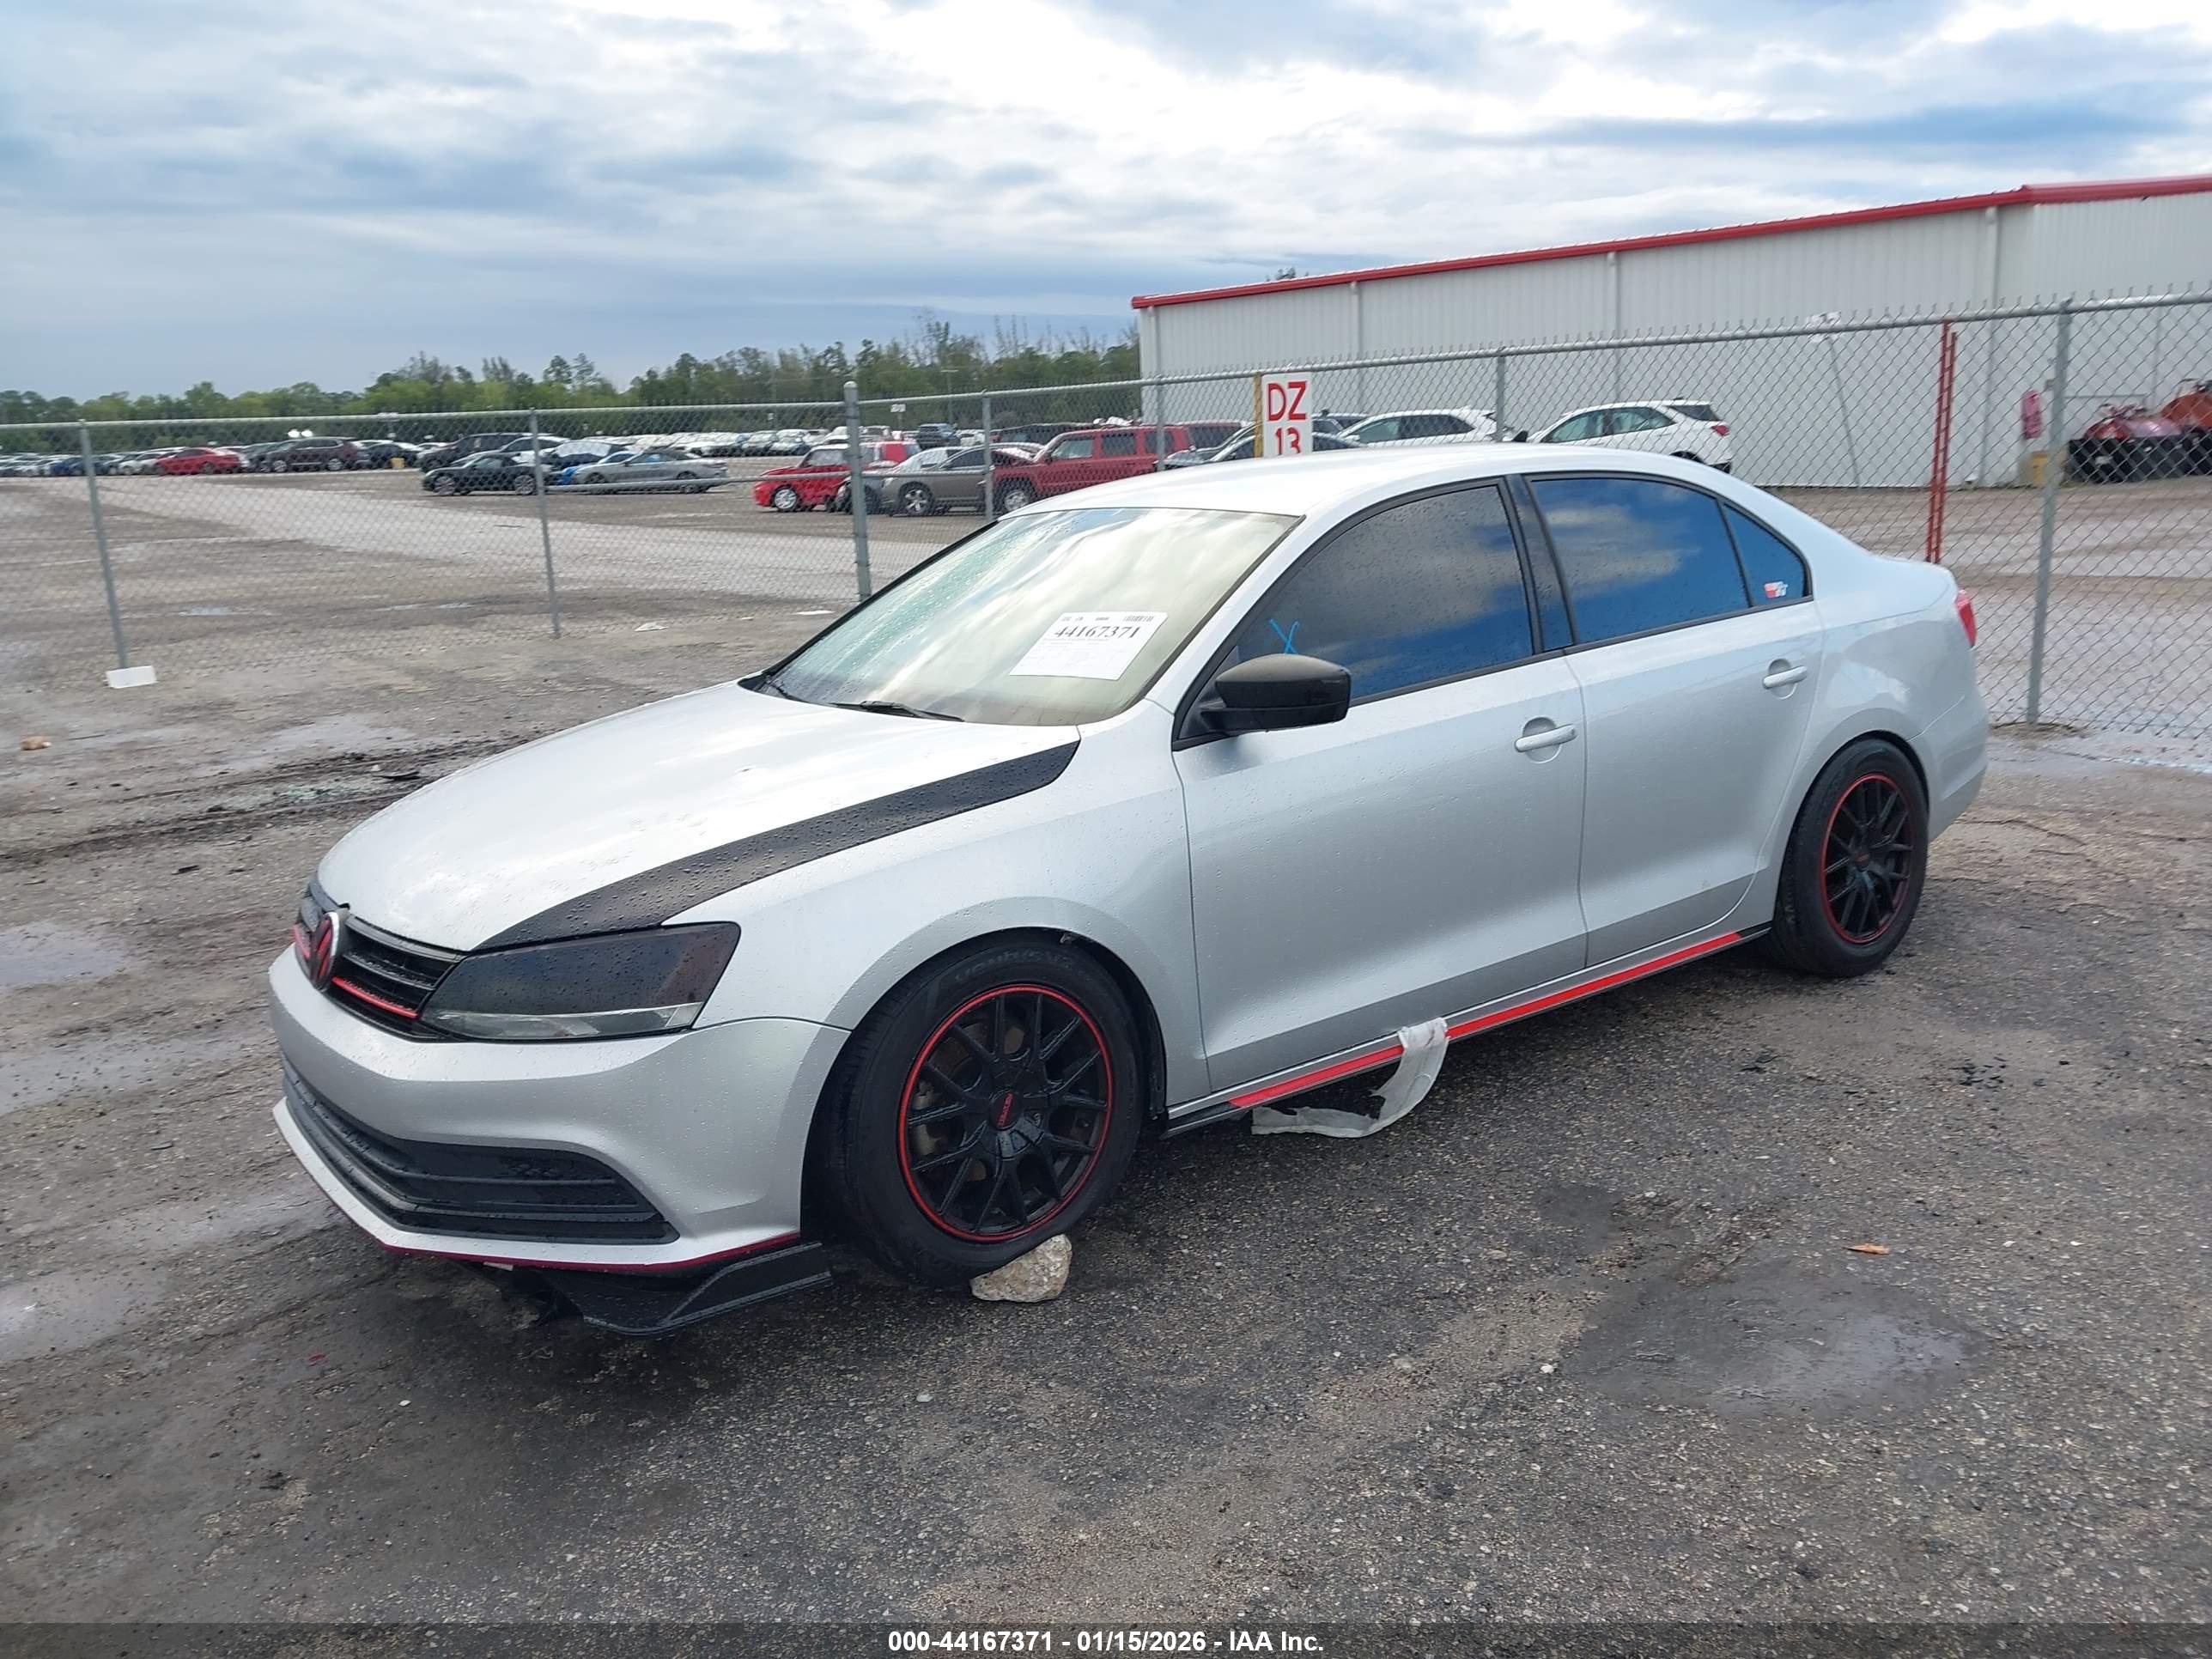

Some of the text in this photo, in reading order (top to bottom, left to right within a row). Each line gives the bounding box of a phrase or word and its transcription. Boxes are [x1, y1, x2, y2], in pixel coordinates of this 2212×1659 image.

[1267, 381, 1307, 421] DZ
[1275, 427, 1301, 455] 13
[1054, 625, 1140, 638] 44167371
